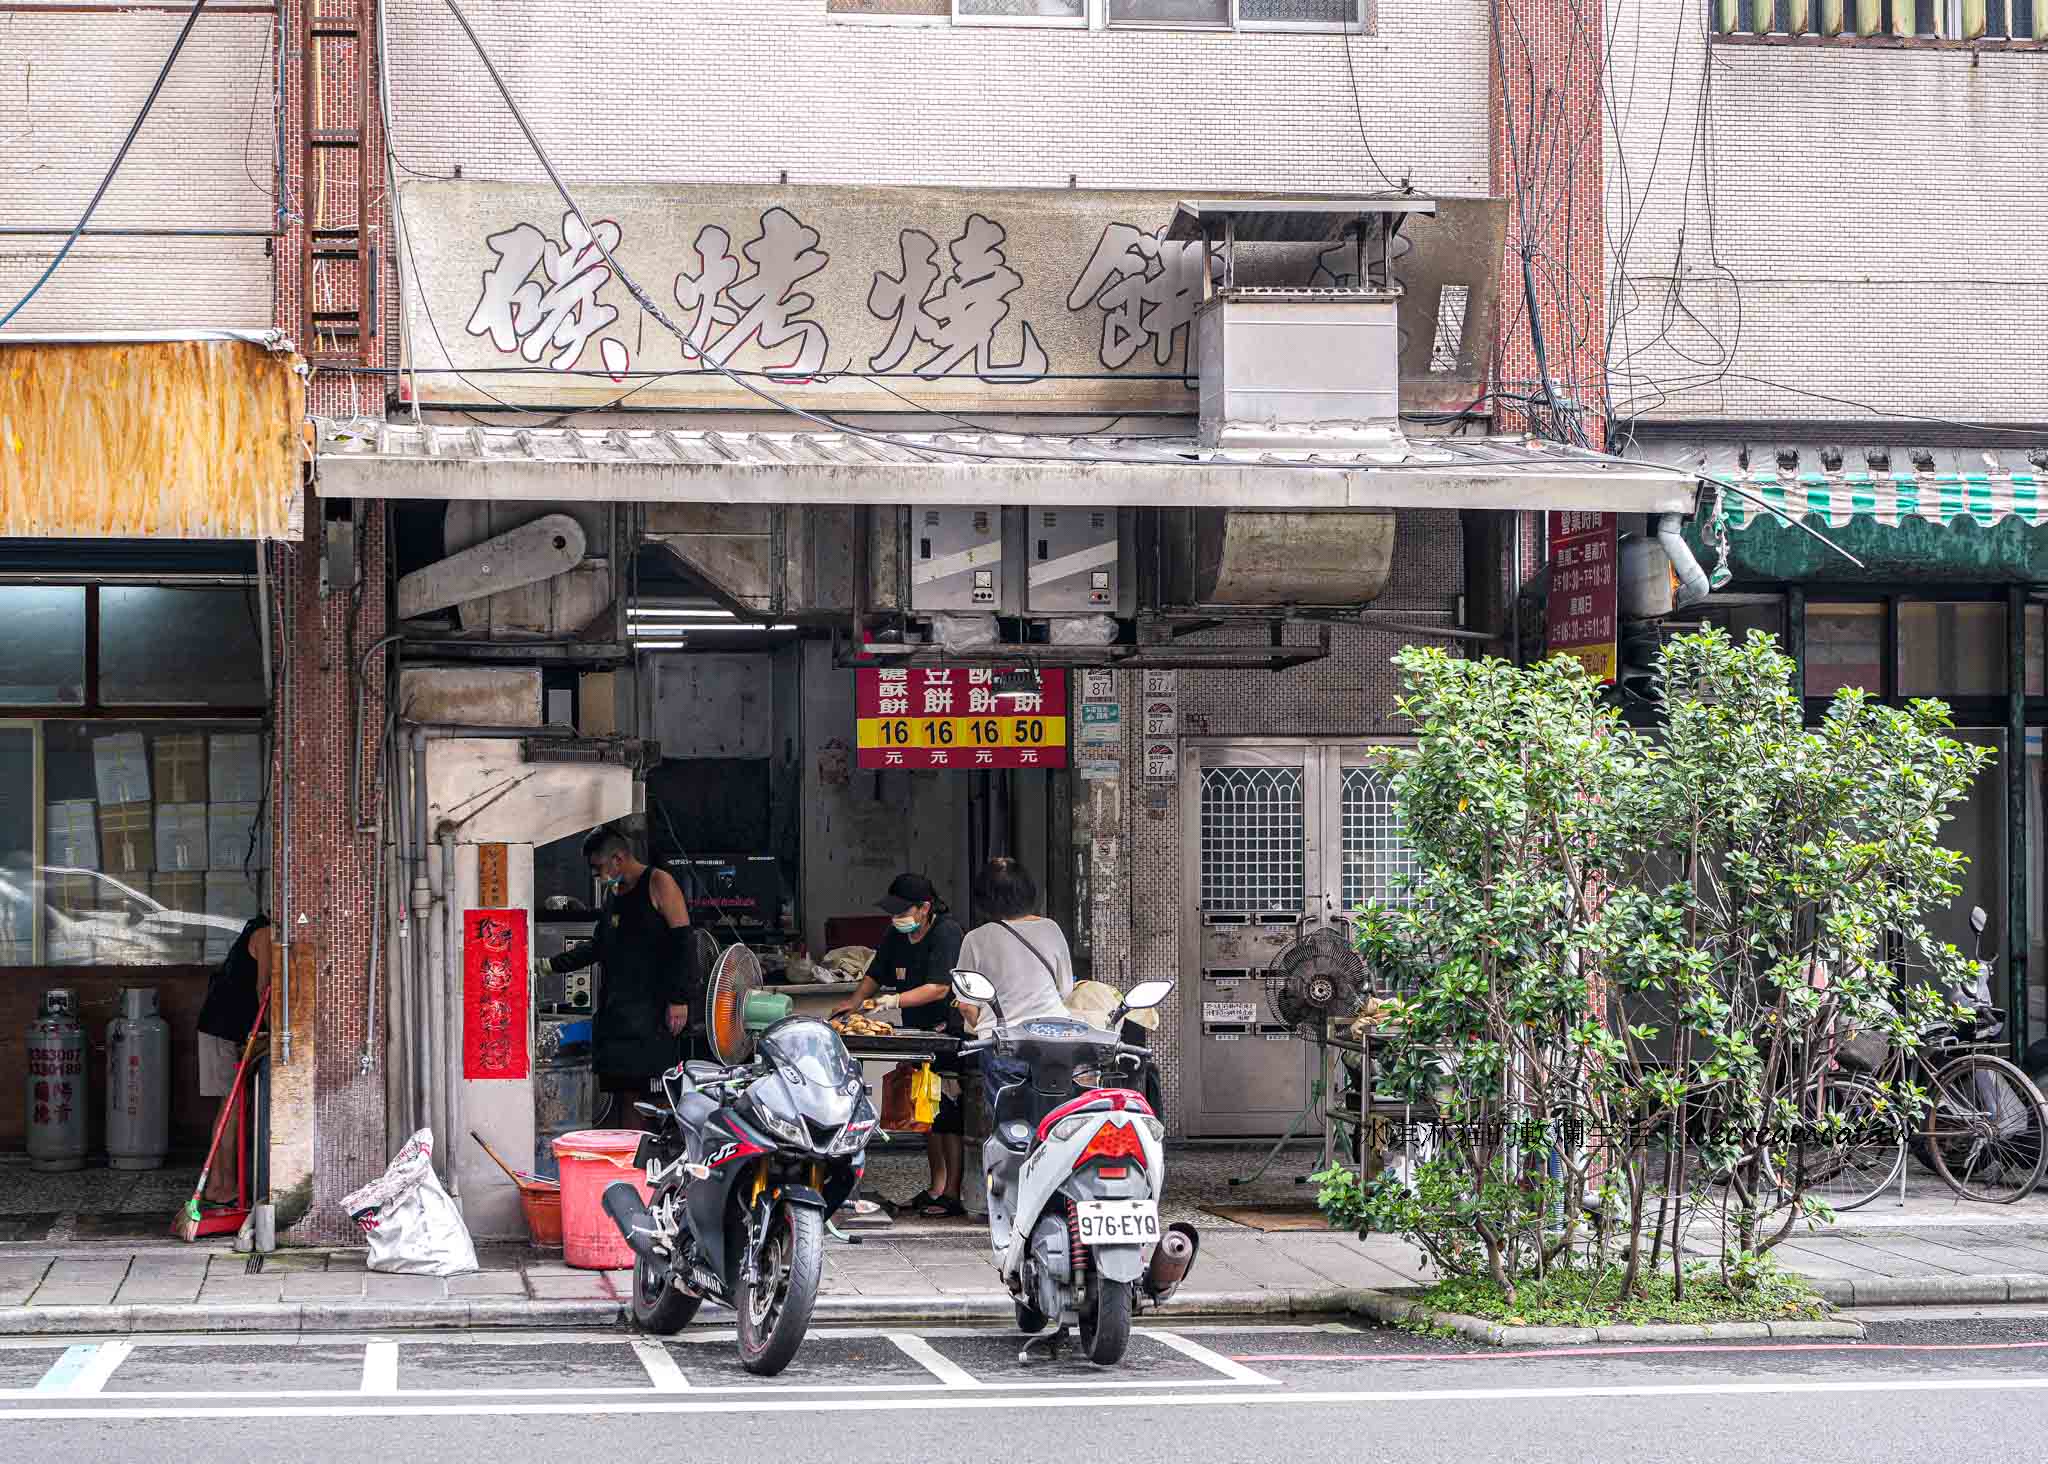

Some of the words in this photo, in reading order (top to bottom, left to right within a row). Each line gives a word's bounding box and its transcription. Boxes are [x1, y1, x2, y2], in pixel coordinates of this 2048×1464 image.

[1093, 683, 1107, 695] 87
[881, 720, 908, 745] 16
[925, 720, 953, 745] 16
[971, 720, 999, 744] 16
[1015, 720, 1043, 743] 50
[885, 752, 903, 765] 元
[930, 752, 948, 764] 元
[975, 751, 993, 764] 元
[1020, 750, 1038, 763] 元
[692, 1267, 723, 1296] YAMAHA
